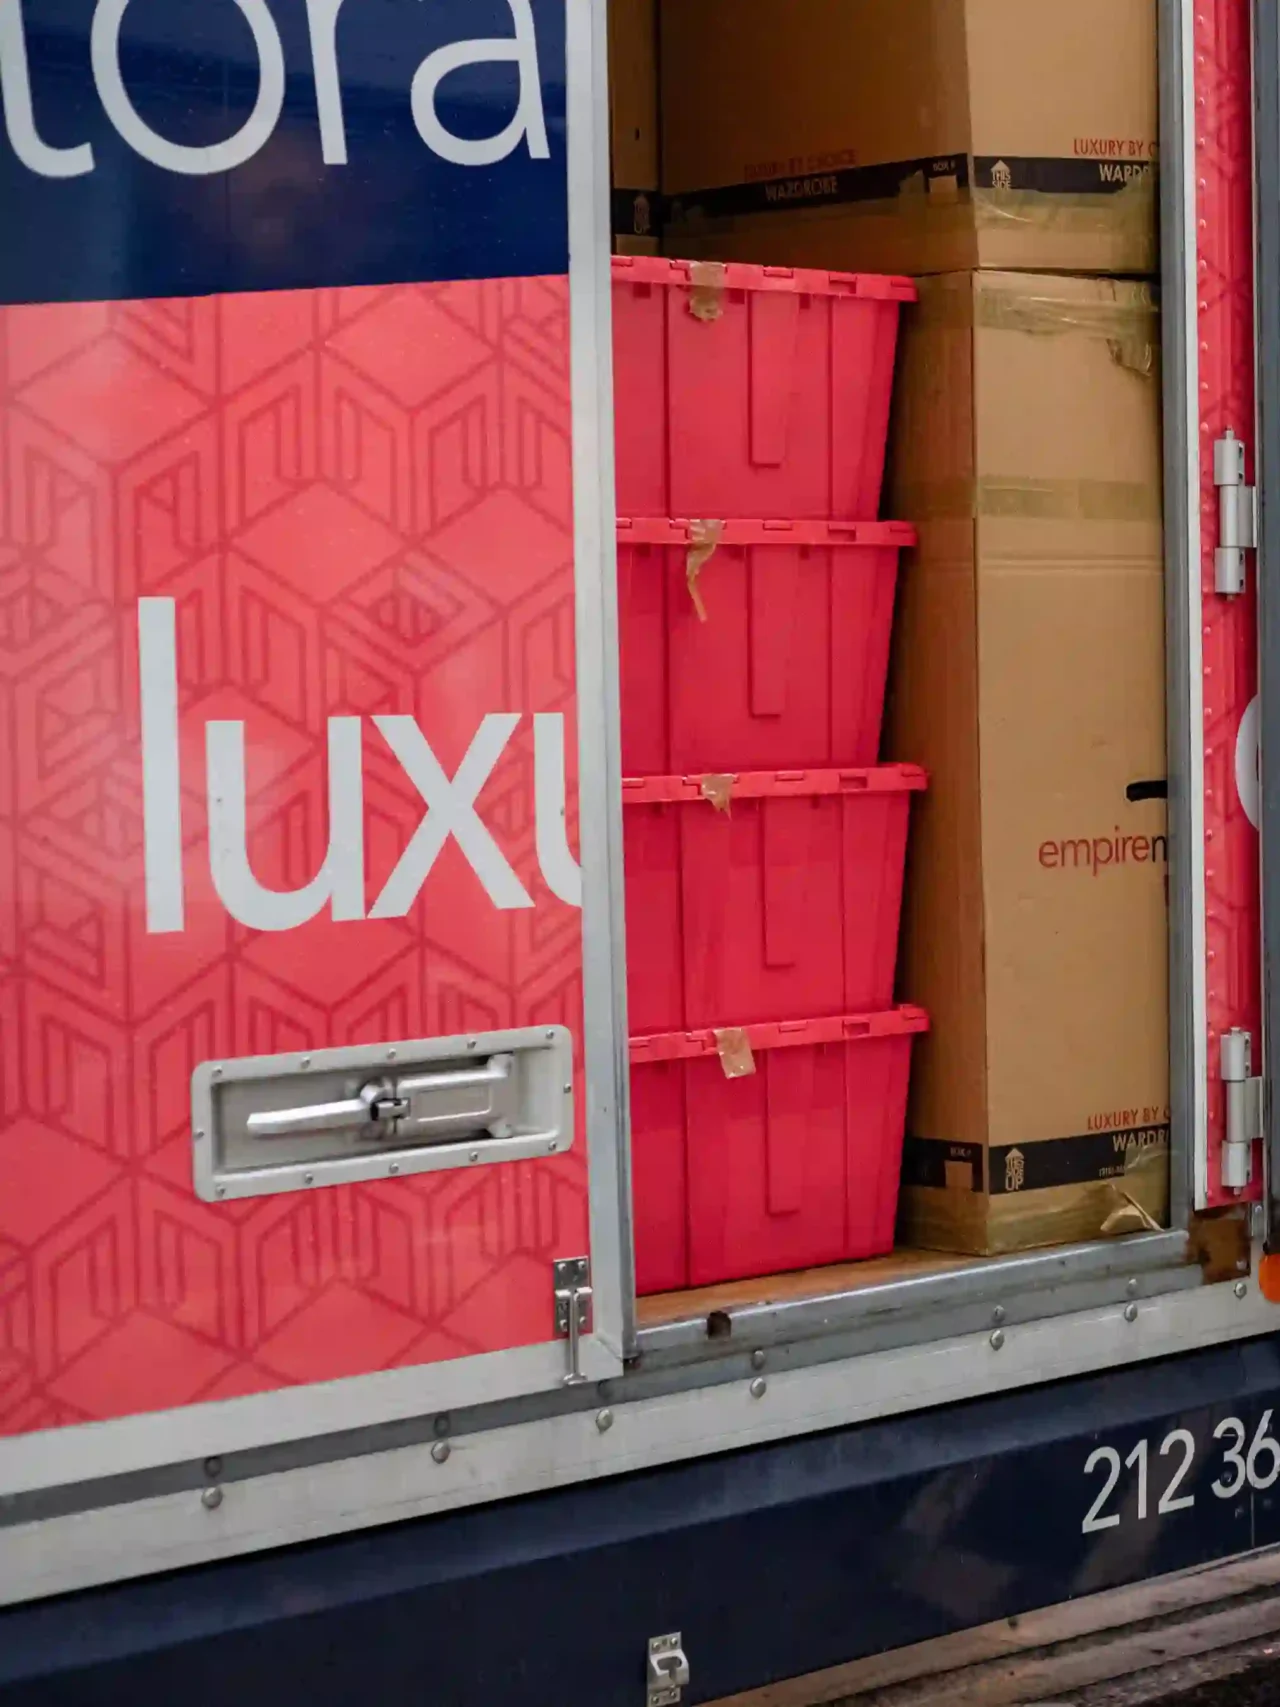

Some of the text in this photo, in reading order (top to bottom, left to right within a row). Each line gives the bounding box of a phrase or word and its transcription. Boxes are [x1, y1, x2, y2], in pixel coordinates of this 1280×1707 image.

[1073, 138, 1124, 155] LUXURY
[1129, 141, 1144, 156] BY
[991, 170, 1011, 180] THIS
[765, 175, 838, 201] WARDROBE
[1087, 1108, 1138, 1131] LUXURY
[1143, 1106, 1159, 1122] BY
[1112, 1128, 1168, 1152] WARDR
[1005, 1174, 1023, 1191] UP
[1082, 1429, 1195, 1534] 212
